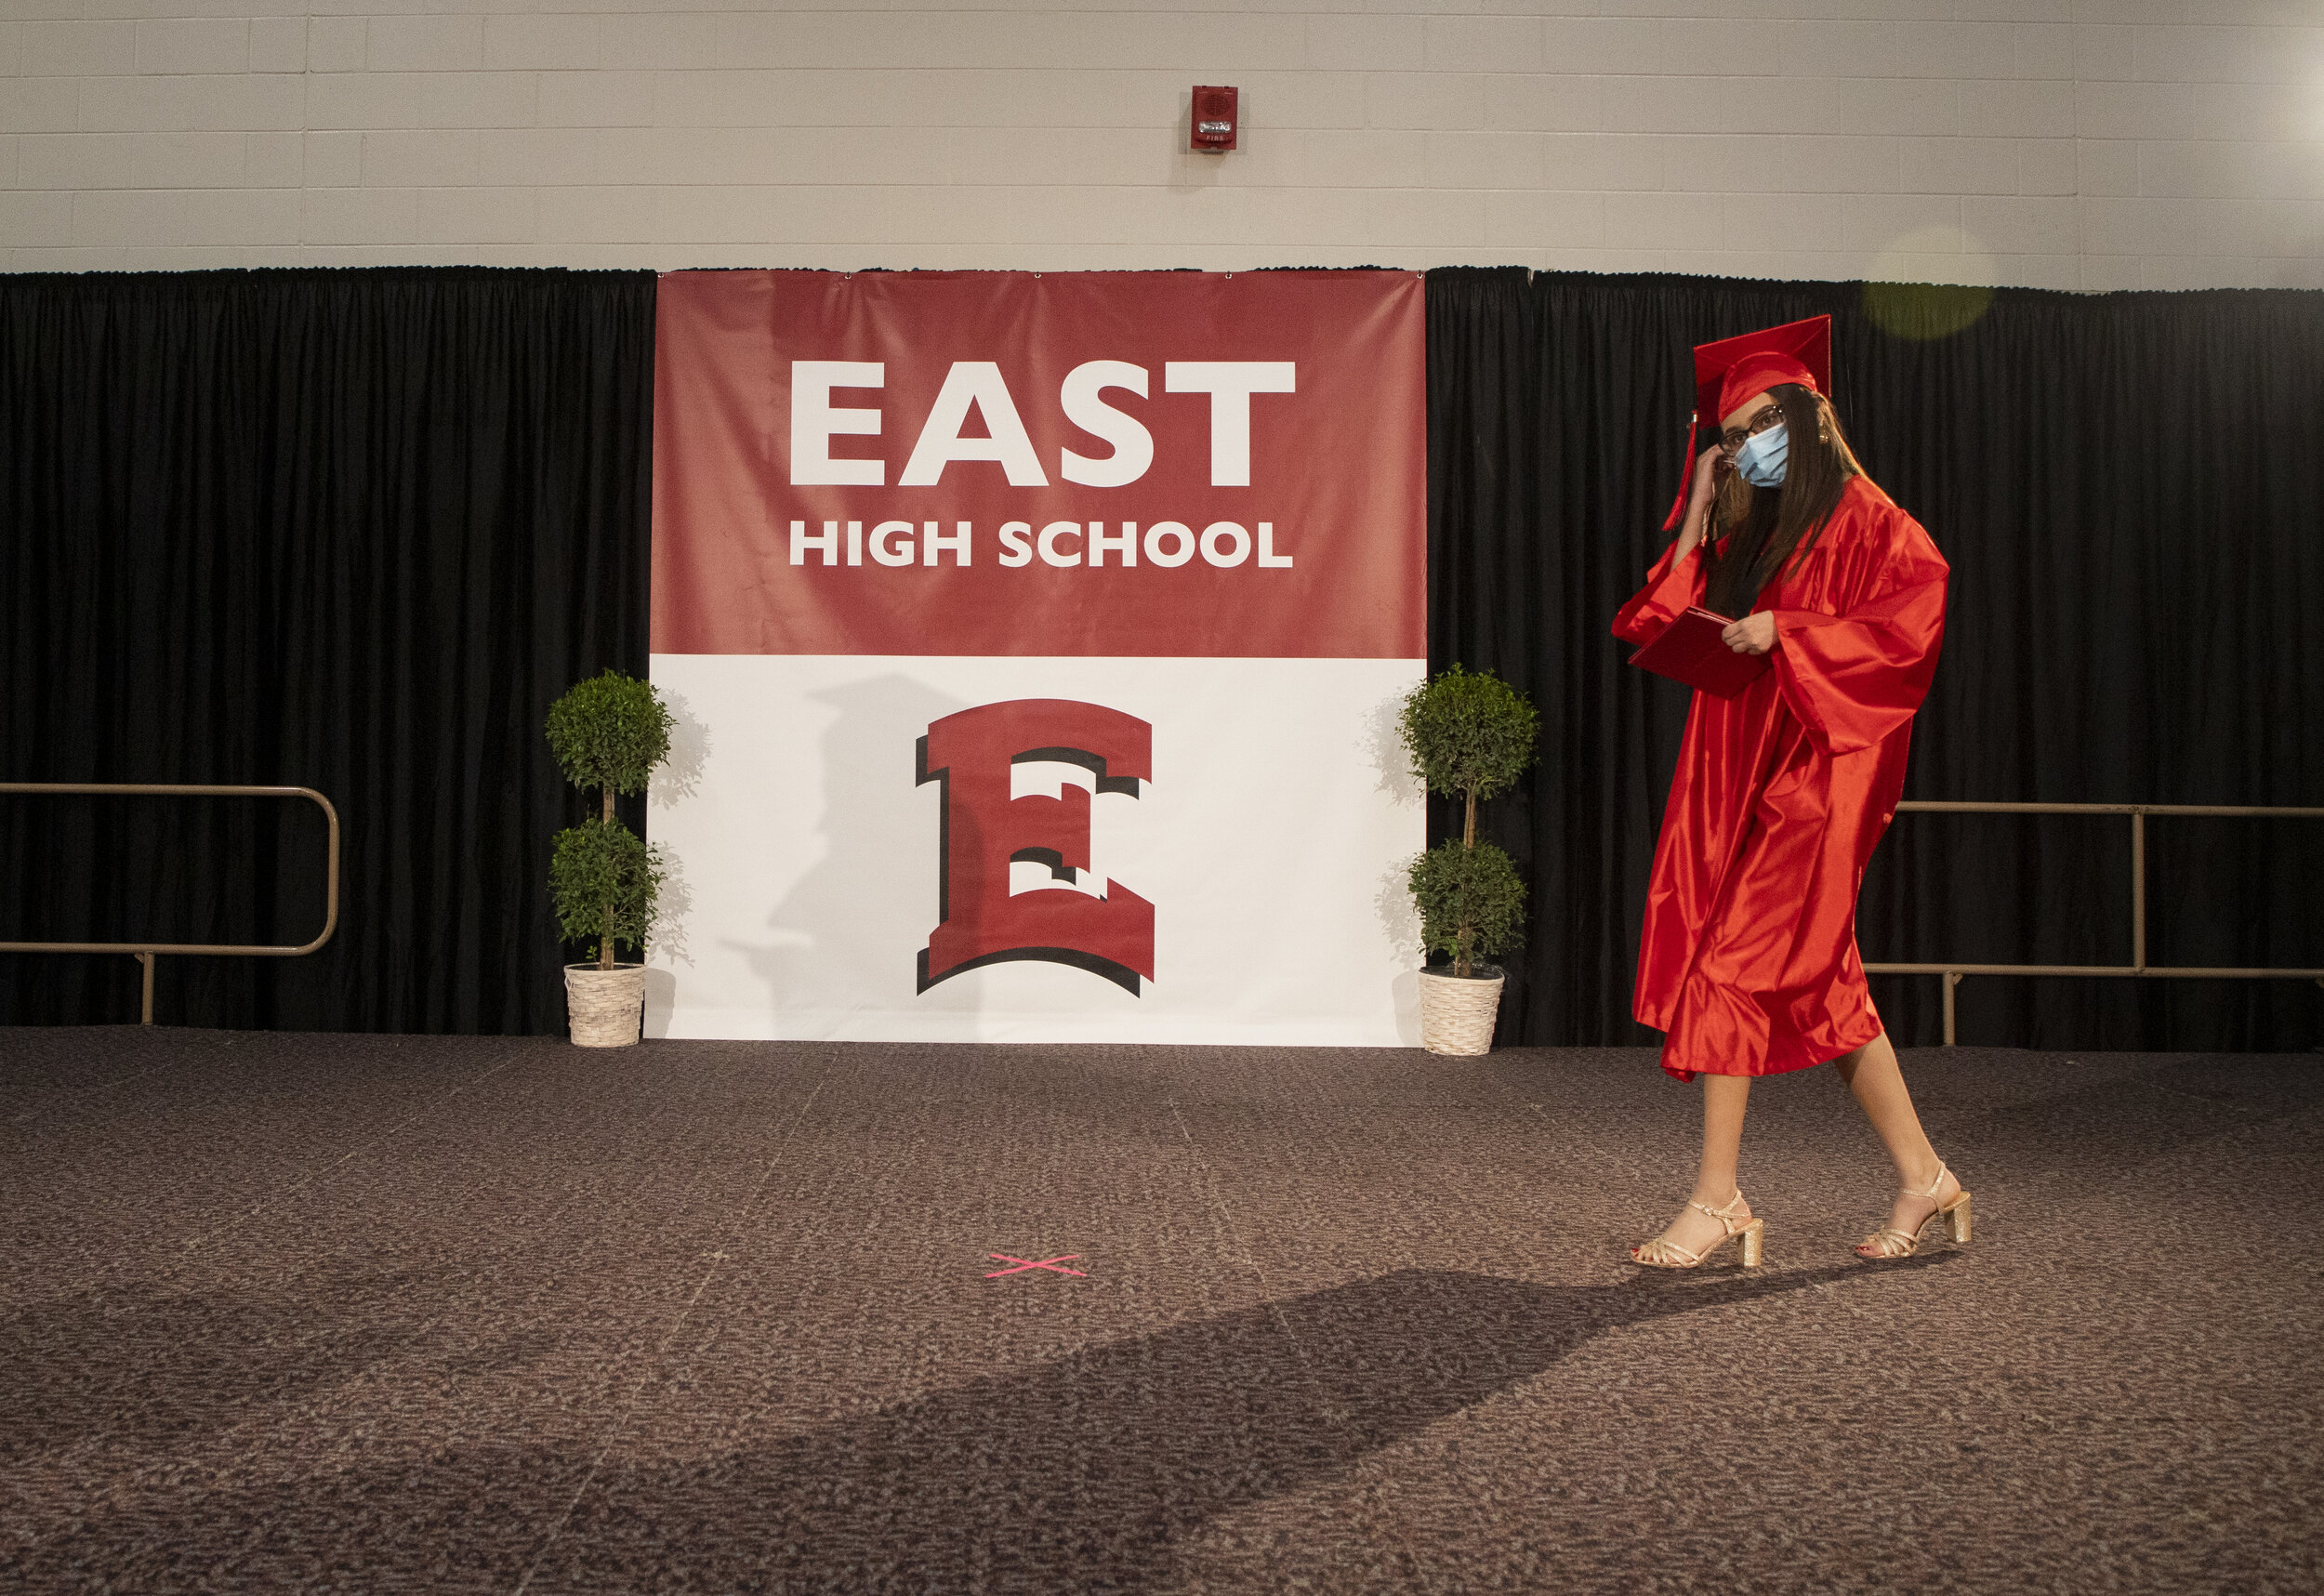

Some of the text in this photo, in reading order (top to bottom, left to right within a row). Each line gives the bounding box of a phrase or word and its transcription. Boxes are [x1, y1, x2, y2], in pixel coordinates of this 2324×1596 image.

[790, 360, 1296, 488] EAST
[789, 520, 1293, 569] HIGH SCHOOL
[915, 698, 1155, 998] E
